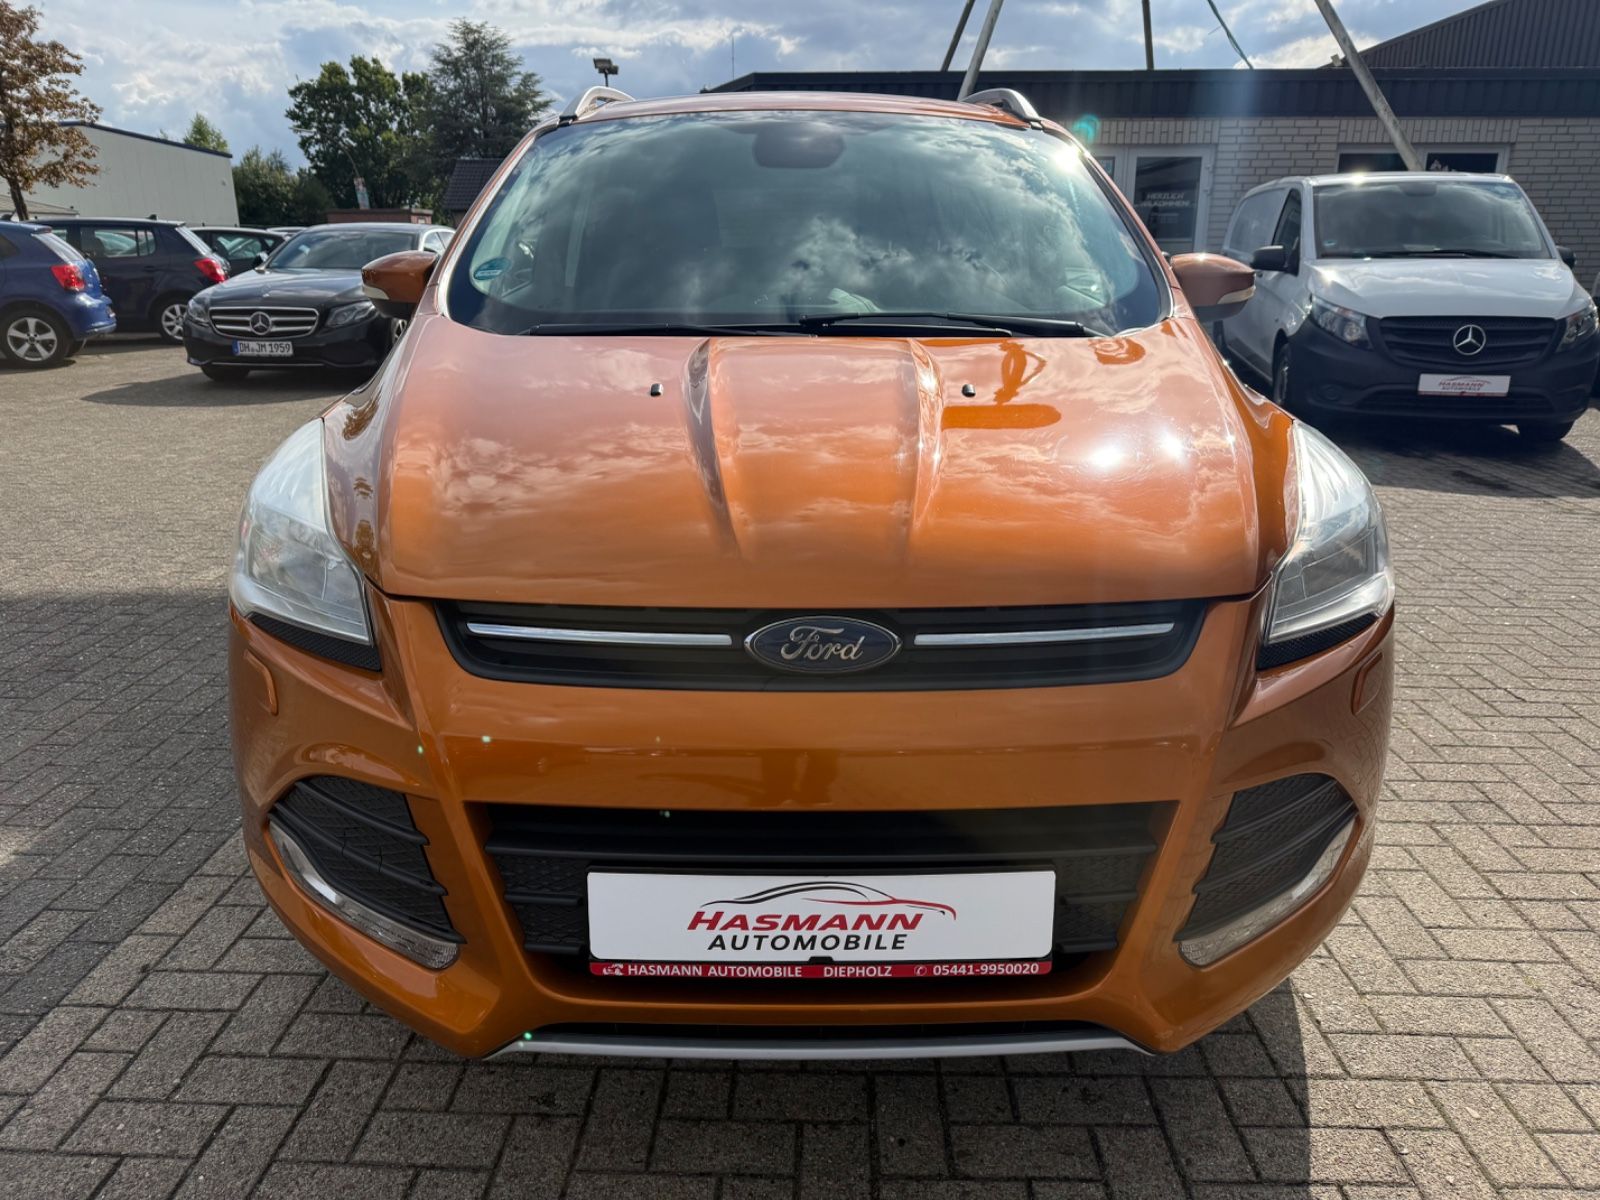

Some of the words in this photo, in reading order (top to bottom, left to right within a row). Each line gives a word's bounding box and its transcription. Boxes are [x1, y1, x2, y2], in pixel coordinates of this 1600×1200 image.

[239, 342, 250, 353] DH
[255, 342, 267, 353] JM
[268, 342, 291, 353] 1959
[780, 625, 866, 661] Ford
[687, 910, 924, 931] HASMANN
[707, 934, 907, 951] AUTOMOBILE
[627, 964, 703, 977] HASMANN
[707, 965, 803, 978] AUTOMOBILE
[823, 964, 893, 978] DIEPHOLZ
[932, 962, 1039, 976] 05441-9950020
